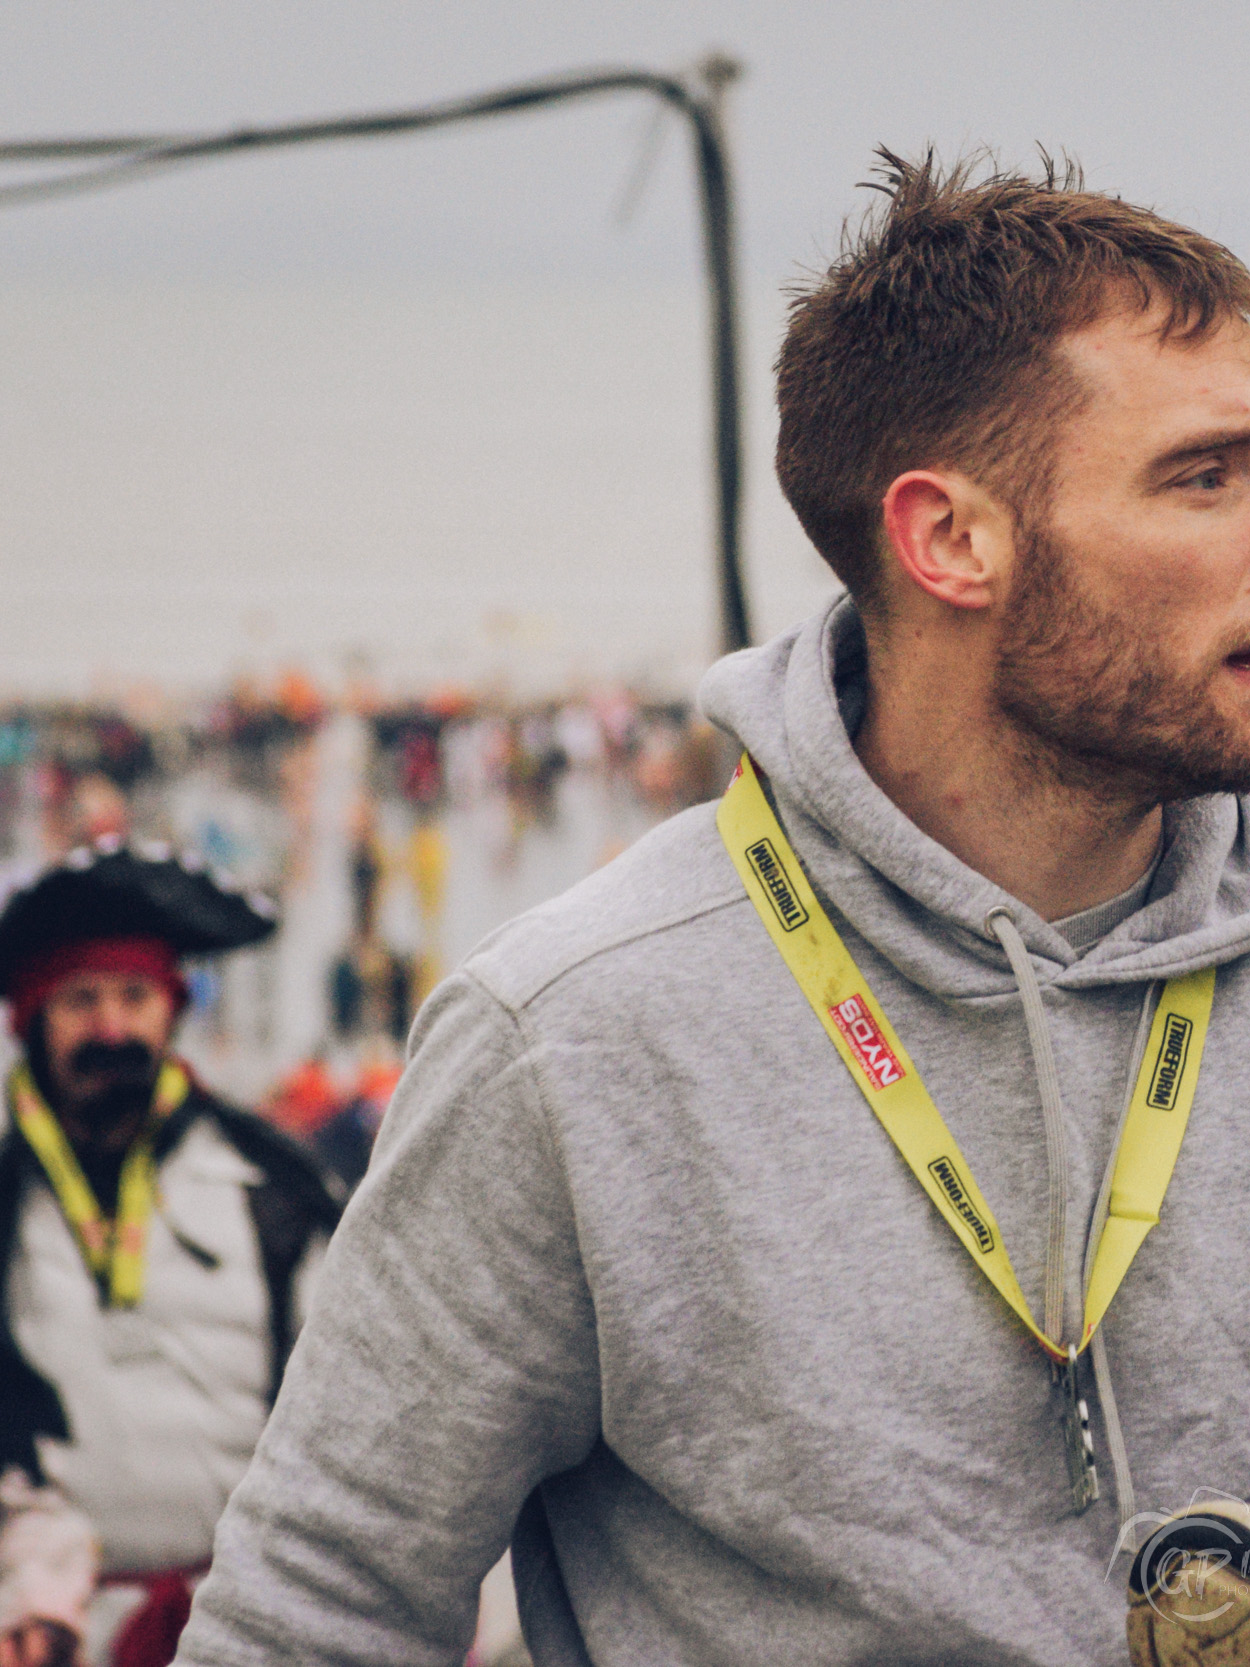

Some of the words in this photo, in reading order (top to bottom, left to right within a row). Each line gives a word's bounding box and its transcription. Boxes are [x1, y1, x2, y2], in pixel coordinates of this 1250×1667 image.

[751, 843, 800, 926] TRUEFORM
[838, 998, 900, 1086] NYDS
[1153, 1021, 1187, 1106] TRUEFORM
[934, 1162, 989, 1248] TRUEFORM
